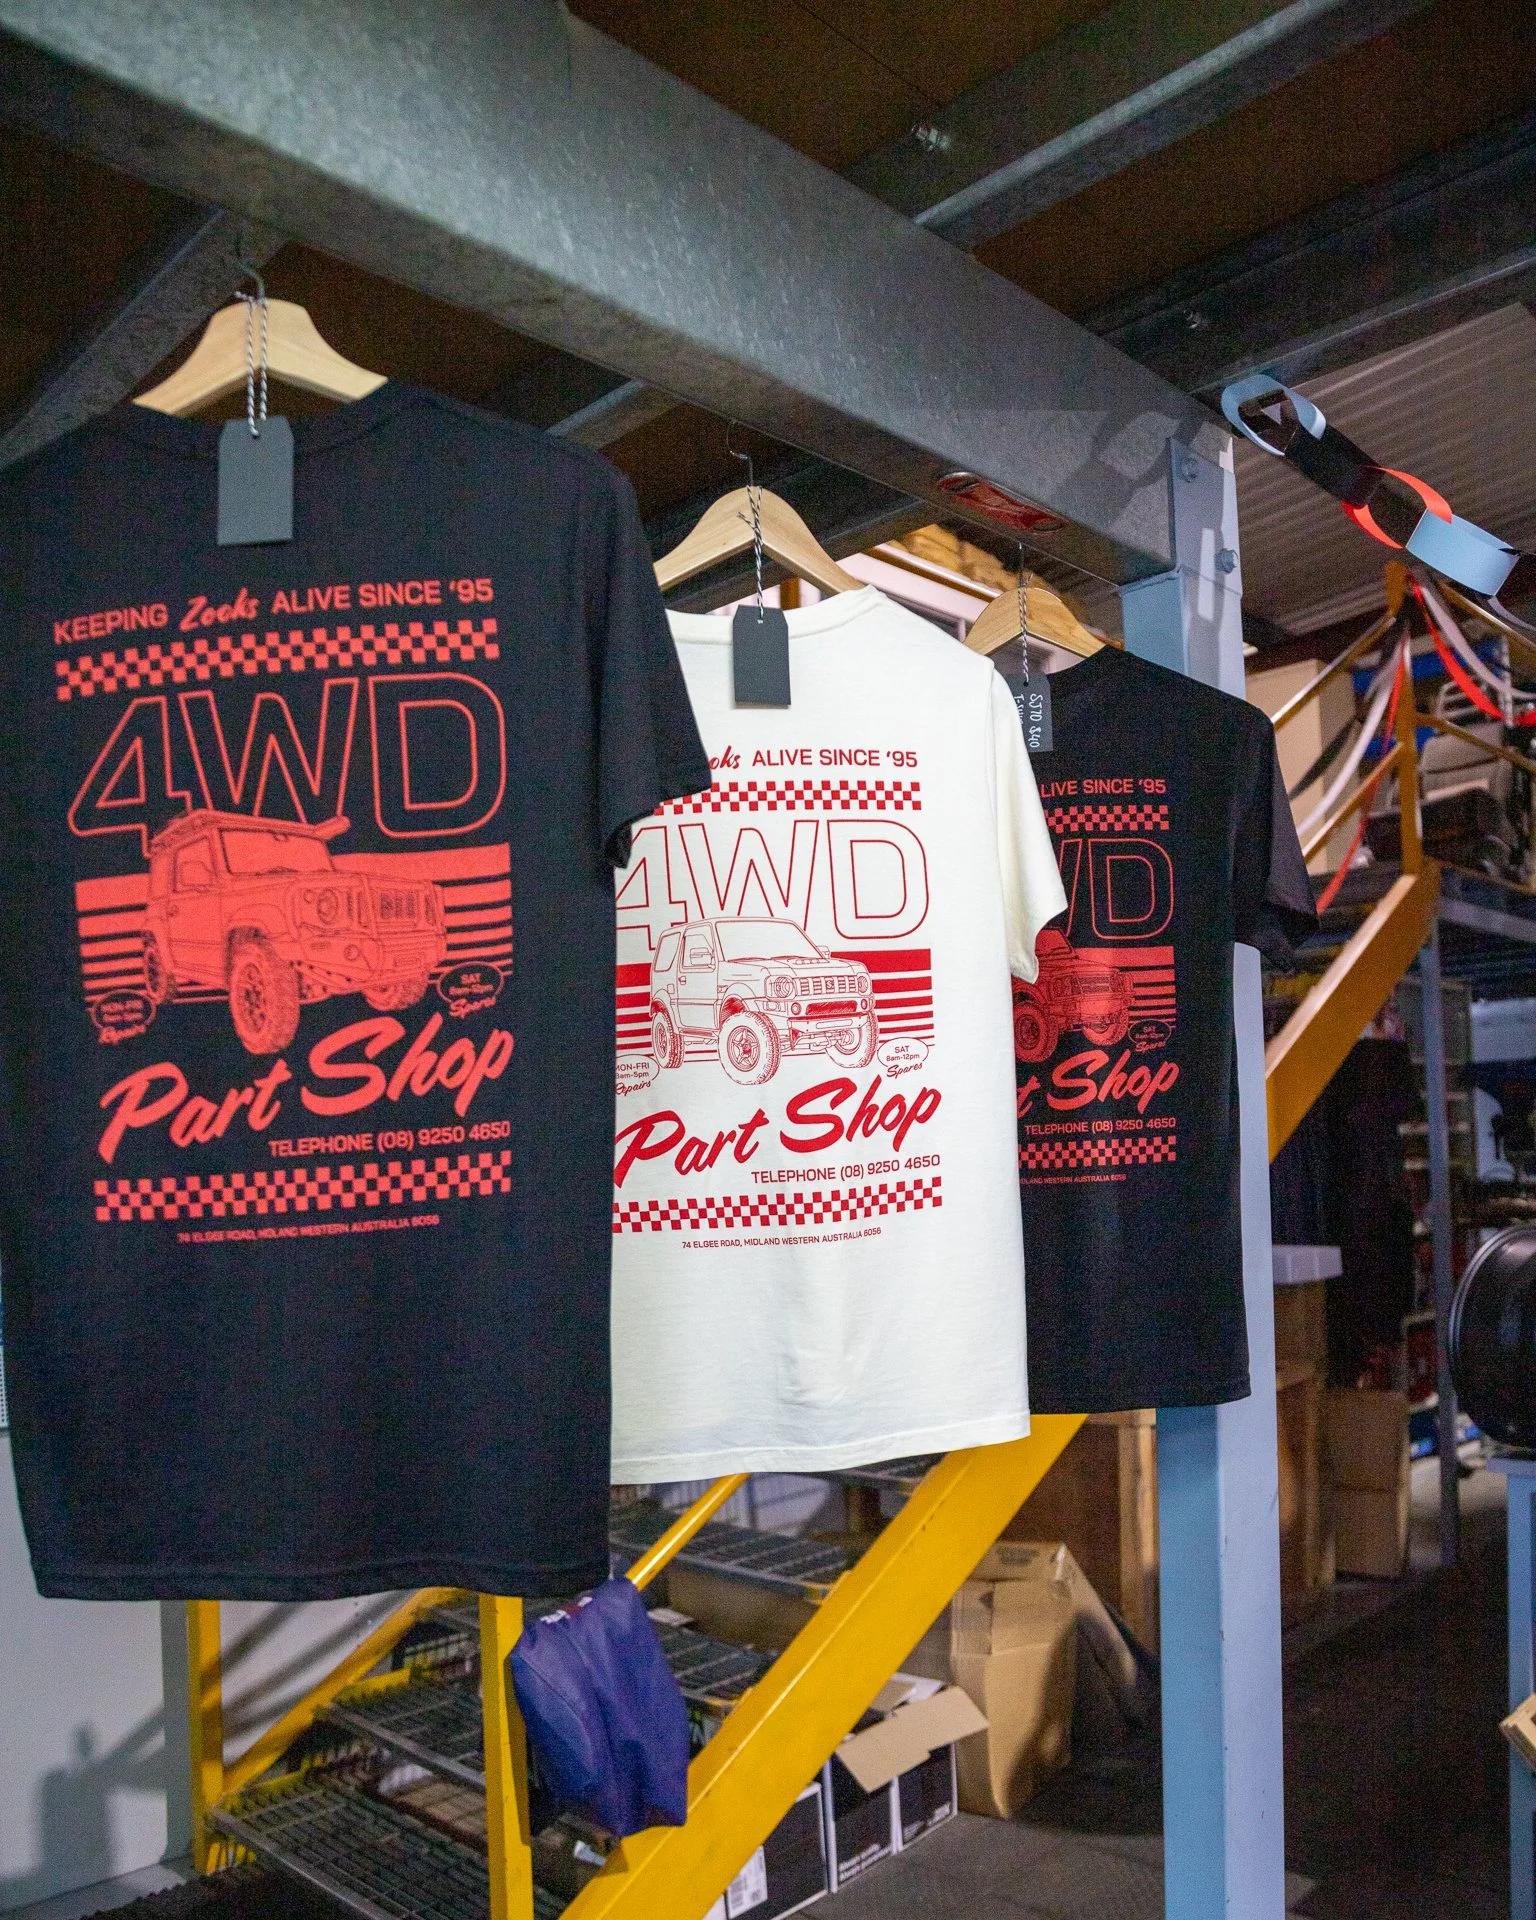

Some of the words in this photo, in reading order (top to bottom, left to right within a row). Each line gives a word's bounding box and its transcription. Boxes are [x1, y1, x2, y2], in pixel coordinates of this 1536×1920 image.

[53, 603, 168, 645] KEEPING
[271, 584, 351, 615] ALIVE
[357, 578, 442, 608] SINCE
[449, 577, 494, 604] '95
[68, 671, 506, 858] 4WD
[709, 745, 741, 770] oks
[752, 749, 812, 767] ALIVE
[819, 749, 880, 767] SINCE
[886, 750, 918, 767] '95
[1040, 780, 1078, 798] LIVE
[1083, 778, 1134, 795] SINCE
[1138, 778, 1167, 795] '95
[616, 820, 929, 951] 4WD
[886, 1053, 920, 1062] 8am-12pm
[895, 1045, 910, 1054] SAT
[98, 1057, 293, 1164] Part
[300, 1012, 516, 1117] Shop
[1046, 1049, 1180, 1114] Shop
[268, 1133, 374, 1157] TELEPHONE
[376, 1129, 415, 1153] (08)
[417, 1125, 465, 1146] 9250
[467, 1119, 511, 1141] 4650
[614, 1108, 769, 1188] Part
[779, 1074, 942, 1152] Shop
[1025, 1122, 1089, 1135] TELEPHONE
[1092, 1120, 1114, 1134] (08)
[1116, 1119, 1144, 1131] 9250
[1146, 1117, 1177, 1129] 4650
[751, 1167, 836, 1184] TELEPHONE
[840, 1164, 864, 1182] (08)
[867, 1159, 900, 1175] 9250
[904, 1154, 940, 1170] 4650
[682, 1241, 692, 1249] 74
[693, 1239, 719, 1248] ELGEE
[720, 1239, 742, 1248] ROAD,
[744, 1237, 780, 1246] MIDLAND
[782, 1235, 820, 1244] WESTERN
[822, 1231, 862, 1243] AUSTRALIA
